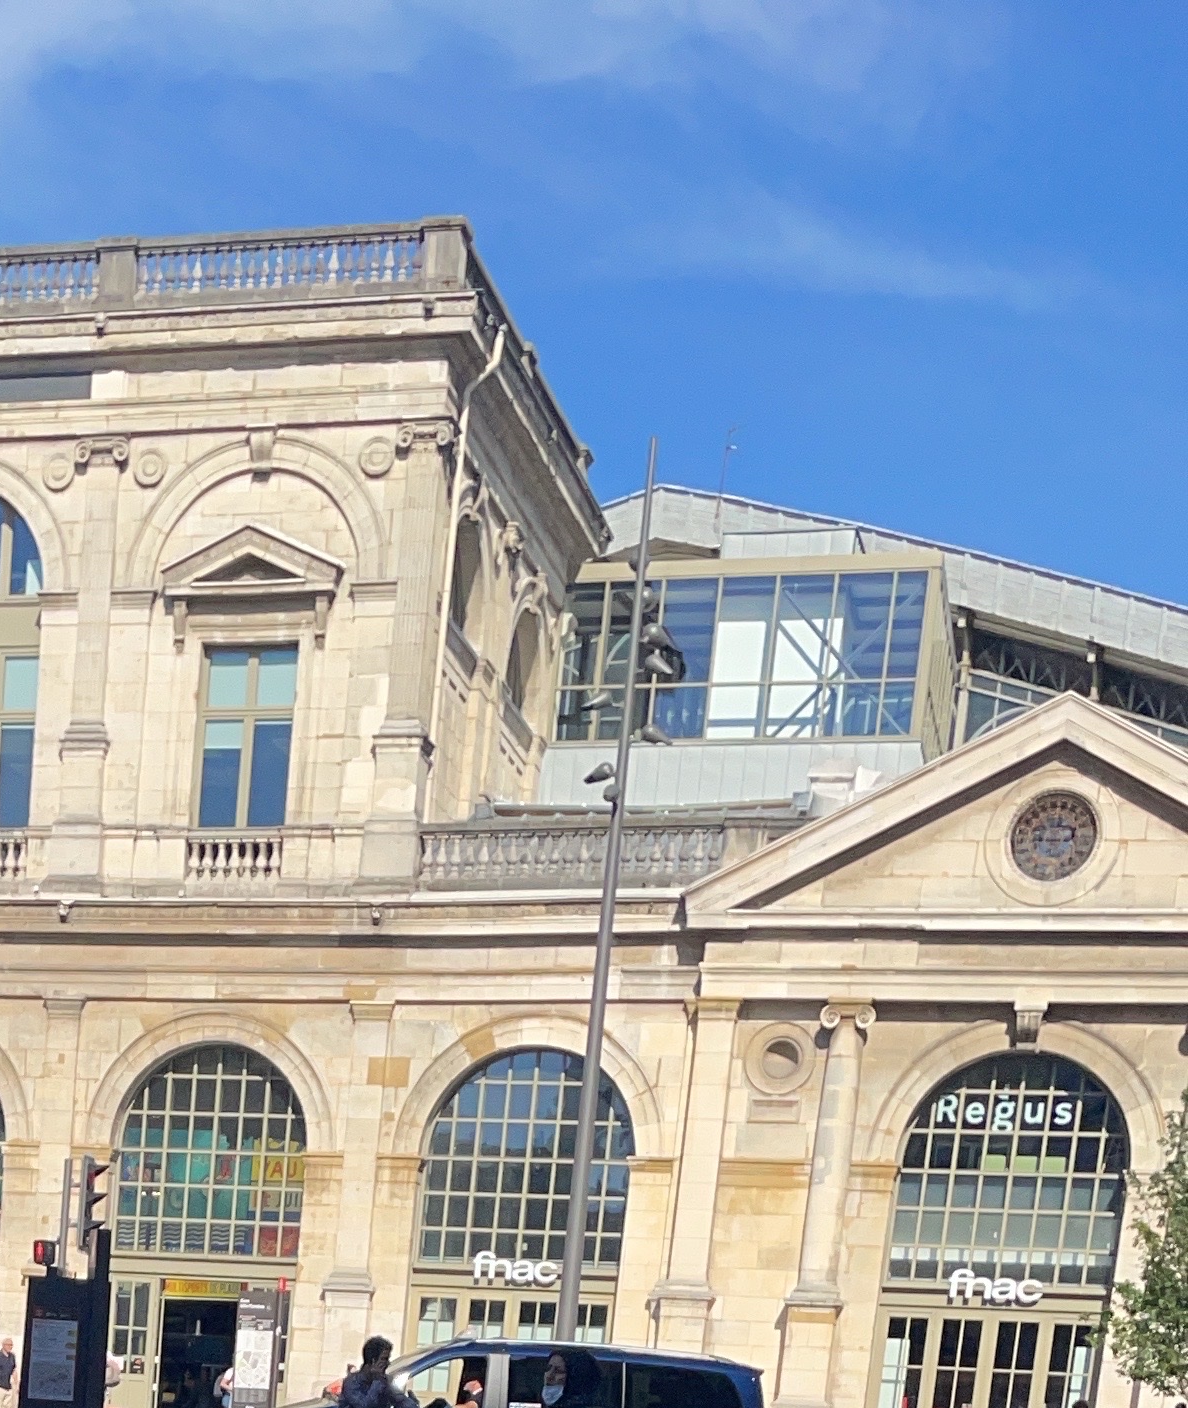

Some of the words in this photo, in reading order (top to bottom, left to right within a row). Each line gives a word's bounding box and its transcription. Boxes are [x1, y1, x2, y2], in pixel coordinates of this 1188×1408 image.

[935, 1093, 1073, 1133] Regus
[473, 1250, 558, 1284] fnac
[949, 1268, 1044, 1305] fnac
